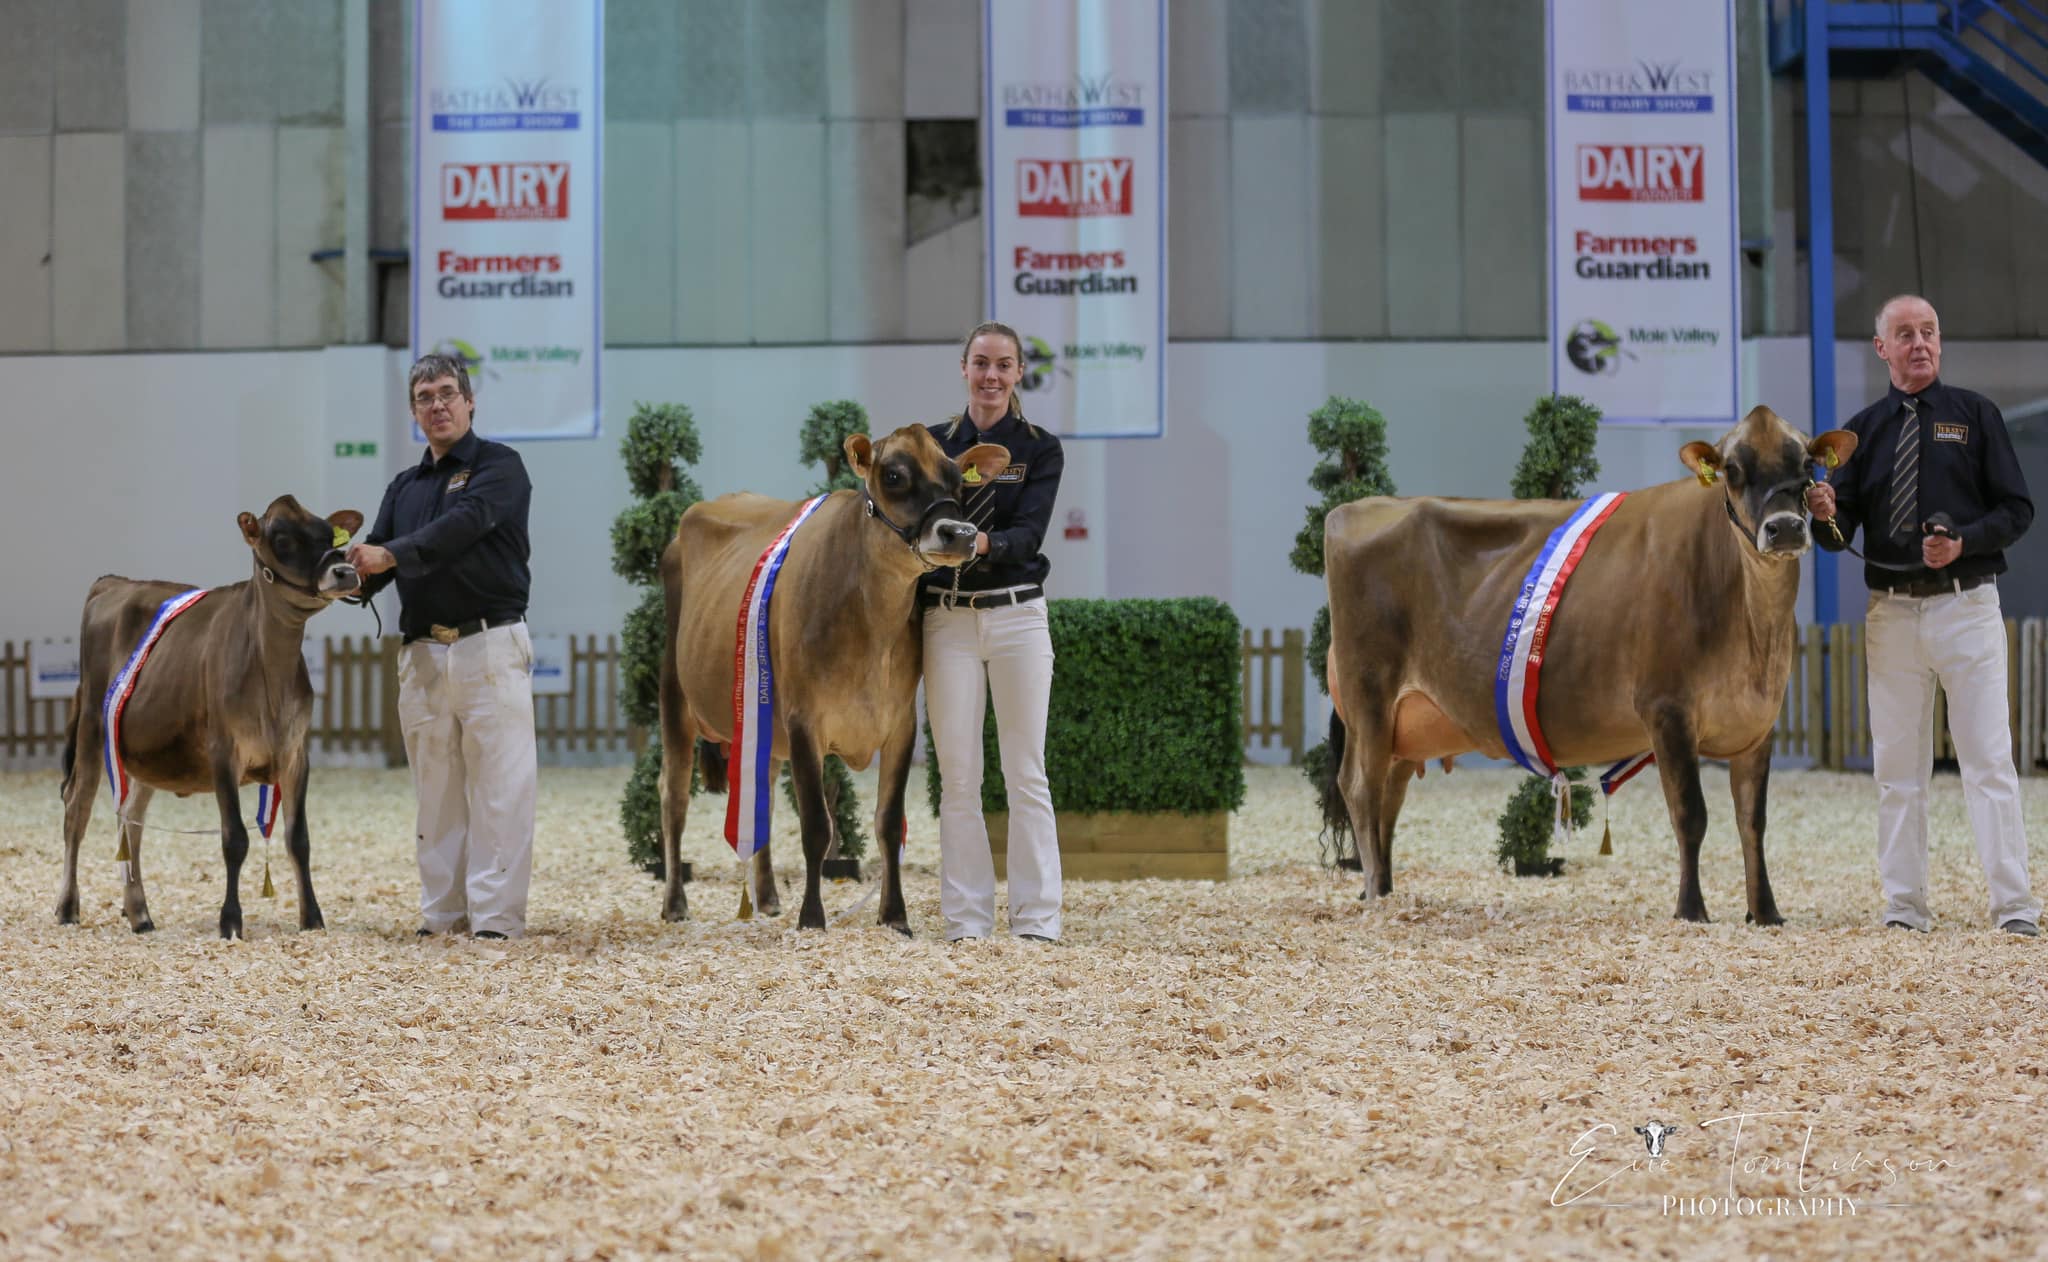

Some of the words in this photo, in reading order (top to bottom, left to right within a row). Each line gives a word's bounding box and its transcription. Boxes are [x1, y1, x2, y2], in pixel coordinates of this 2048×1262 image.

[1581, 147, 1701, 190] DAIRY
[445, 166, 566, 209] DAIRY
[1020, 160, 1131, 205] DAIRY
[1575, 230, 1697, 255] Farmers
[438, 250, 561, 273] Farmers
[1014, 246, 1125, 270] Farmers
[1575, 255, 1711, 280] Guardian
[437, 275, 574, 299] Guardian
[1014, 272, 1138, 296] Guardian
[1628, 327, 1668, 344] Mole
[1672, 326, 1721, 348] Valley
[491, 346, 529, 361] Mole
[536, 345, 583, 366] Valley
[1063, 344, 1097, 359] Mole
[1102, 343, 1147, 363] Valley
[1515, 583, 1535, 617] DAIRY
[1505, 617, 1522, 653] SHOW
[1529, 604, 1552, 663] SUPREME
[758, 629, 767, 665] SHOW
[758, 668, 770, 705] DAIRY
